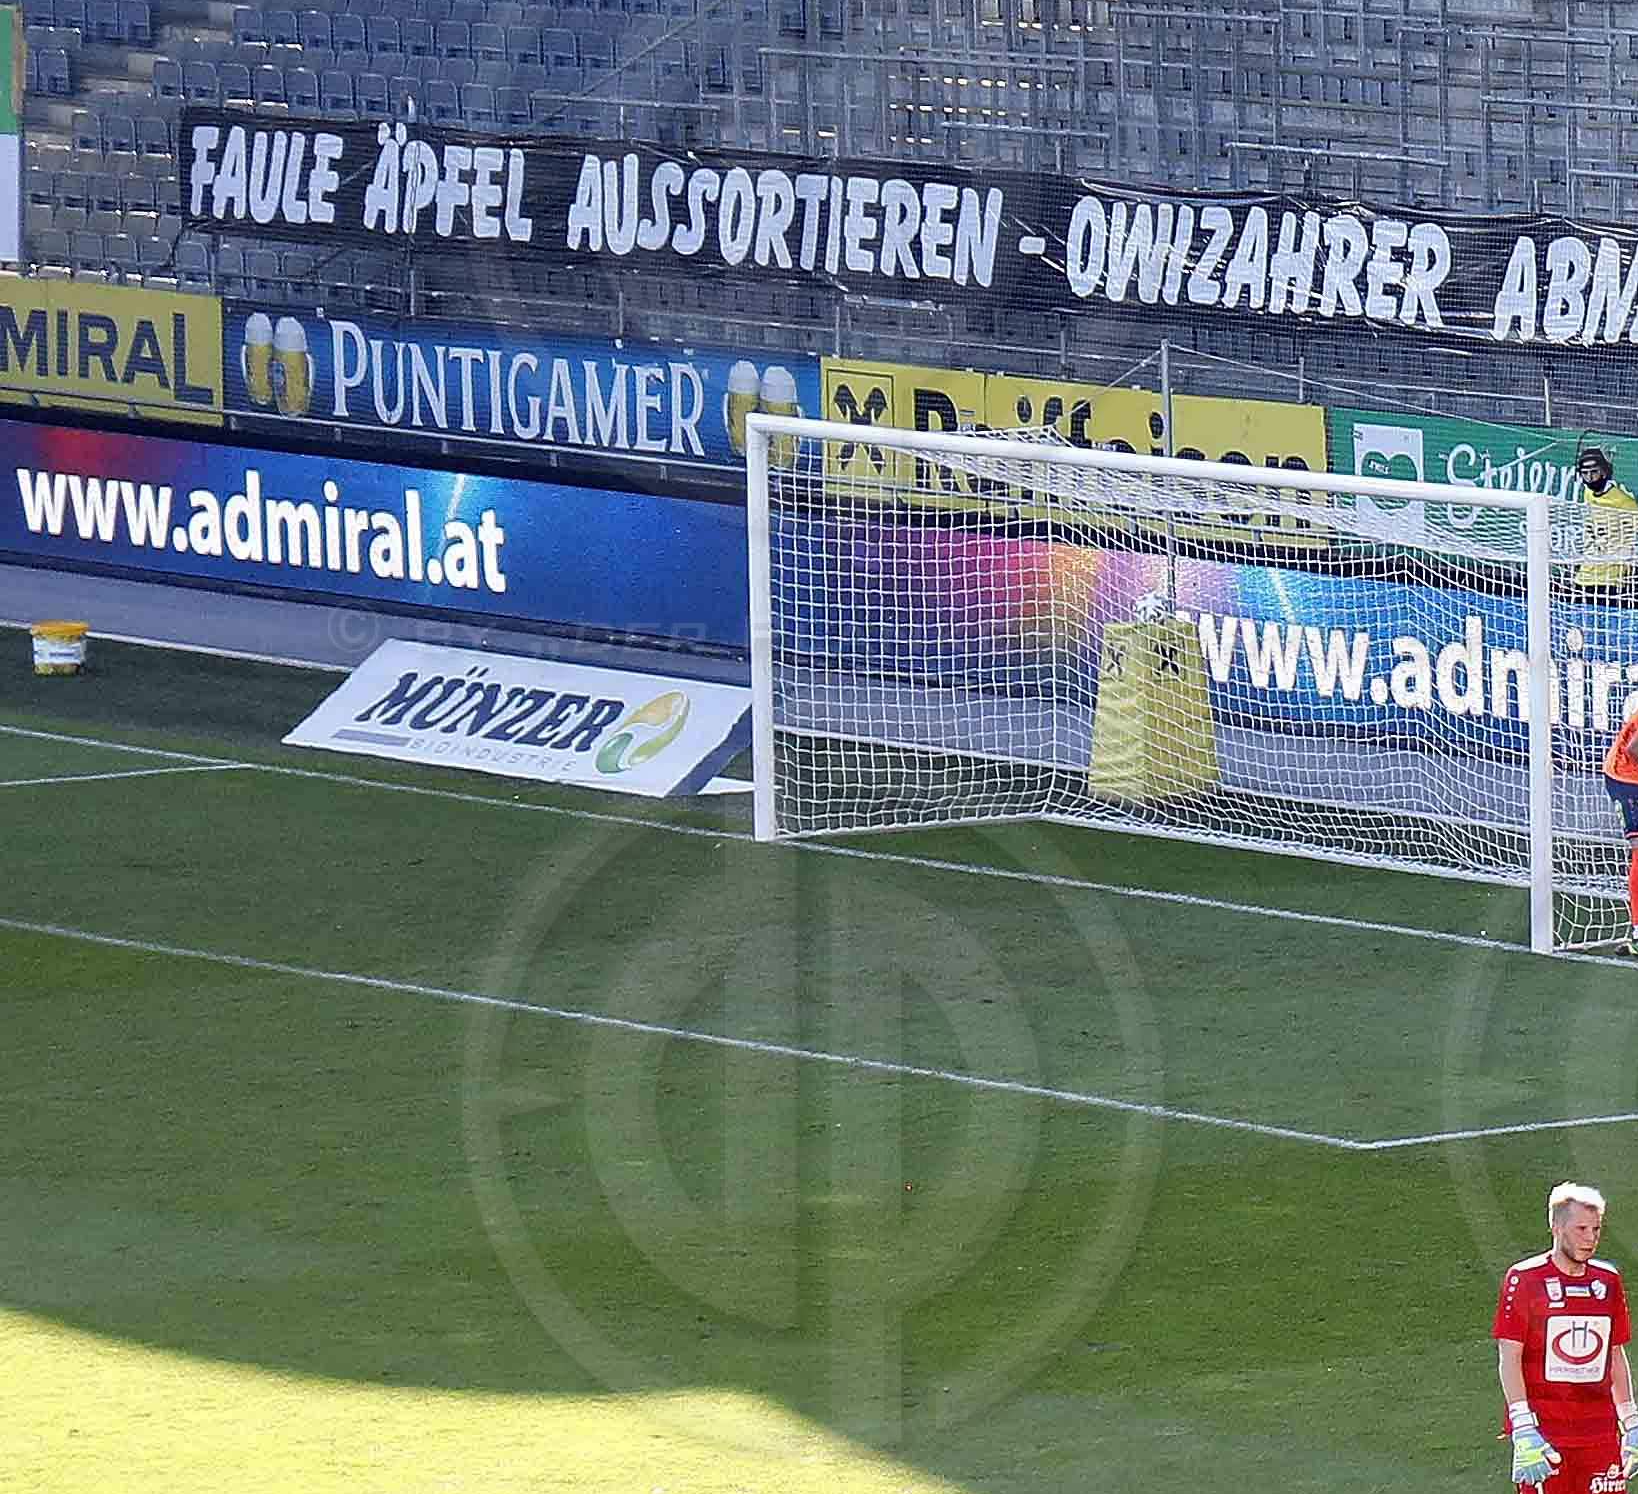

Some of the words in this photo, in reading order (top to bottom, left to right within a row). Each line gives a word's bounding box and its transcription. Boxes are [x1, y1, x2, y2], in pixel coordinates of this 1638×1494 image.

[190, 124, 343, 224] FAULE
[363, 120, 533, 243] ÄPFEL
[566, 152, 1003, 287] AUSSORTIEREN
[330, 319, 705, 456] PUNTIGAMER
[16, 468, 507, 593] www.admiral.at
[355, 666, 625, 753] MÜNZER
